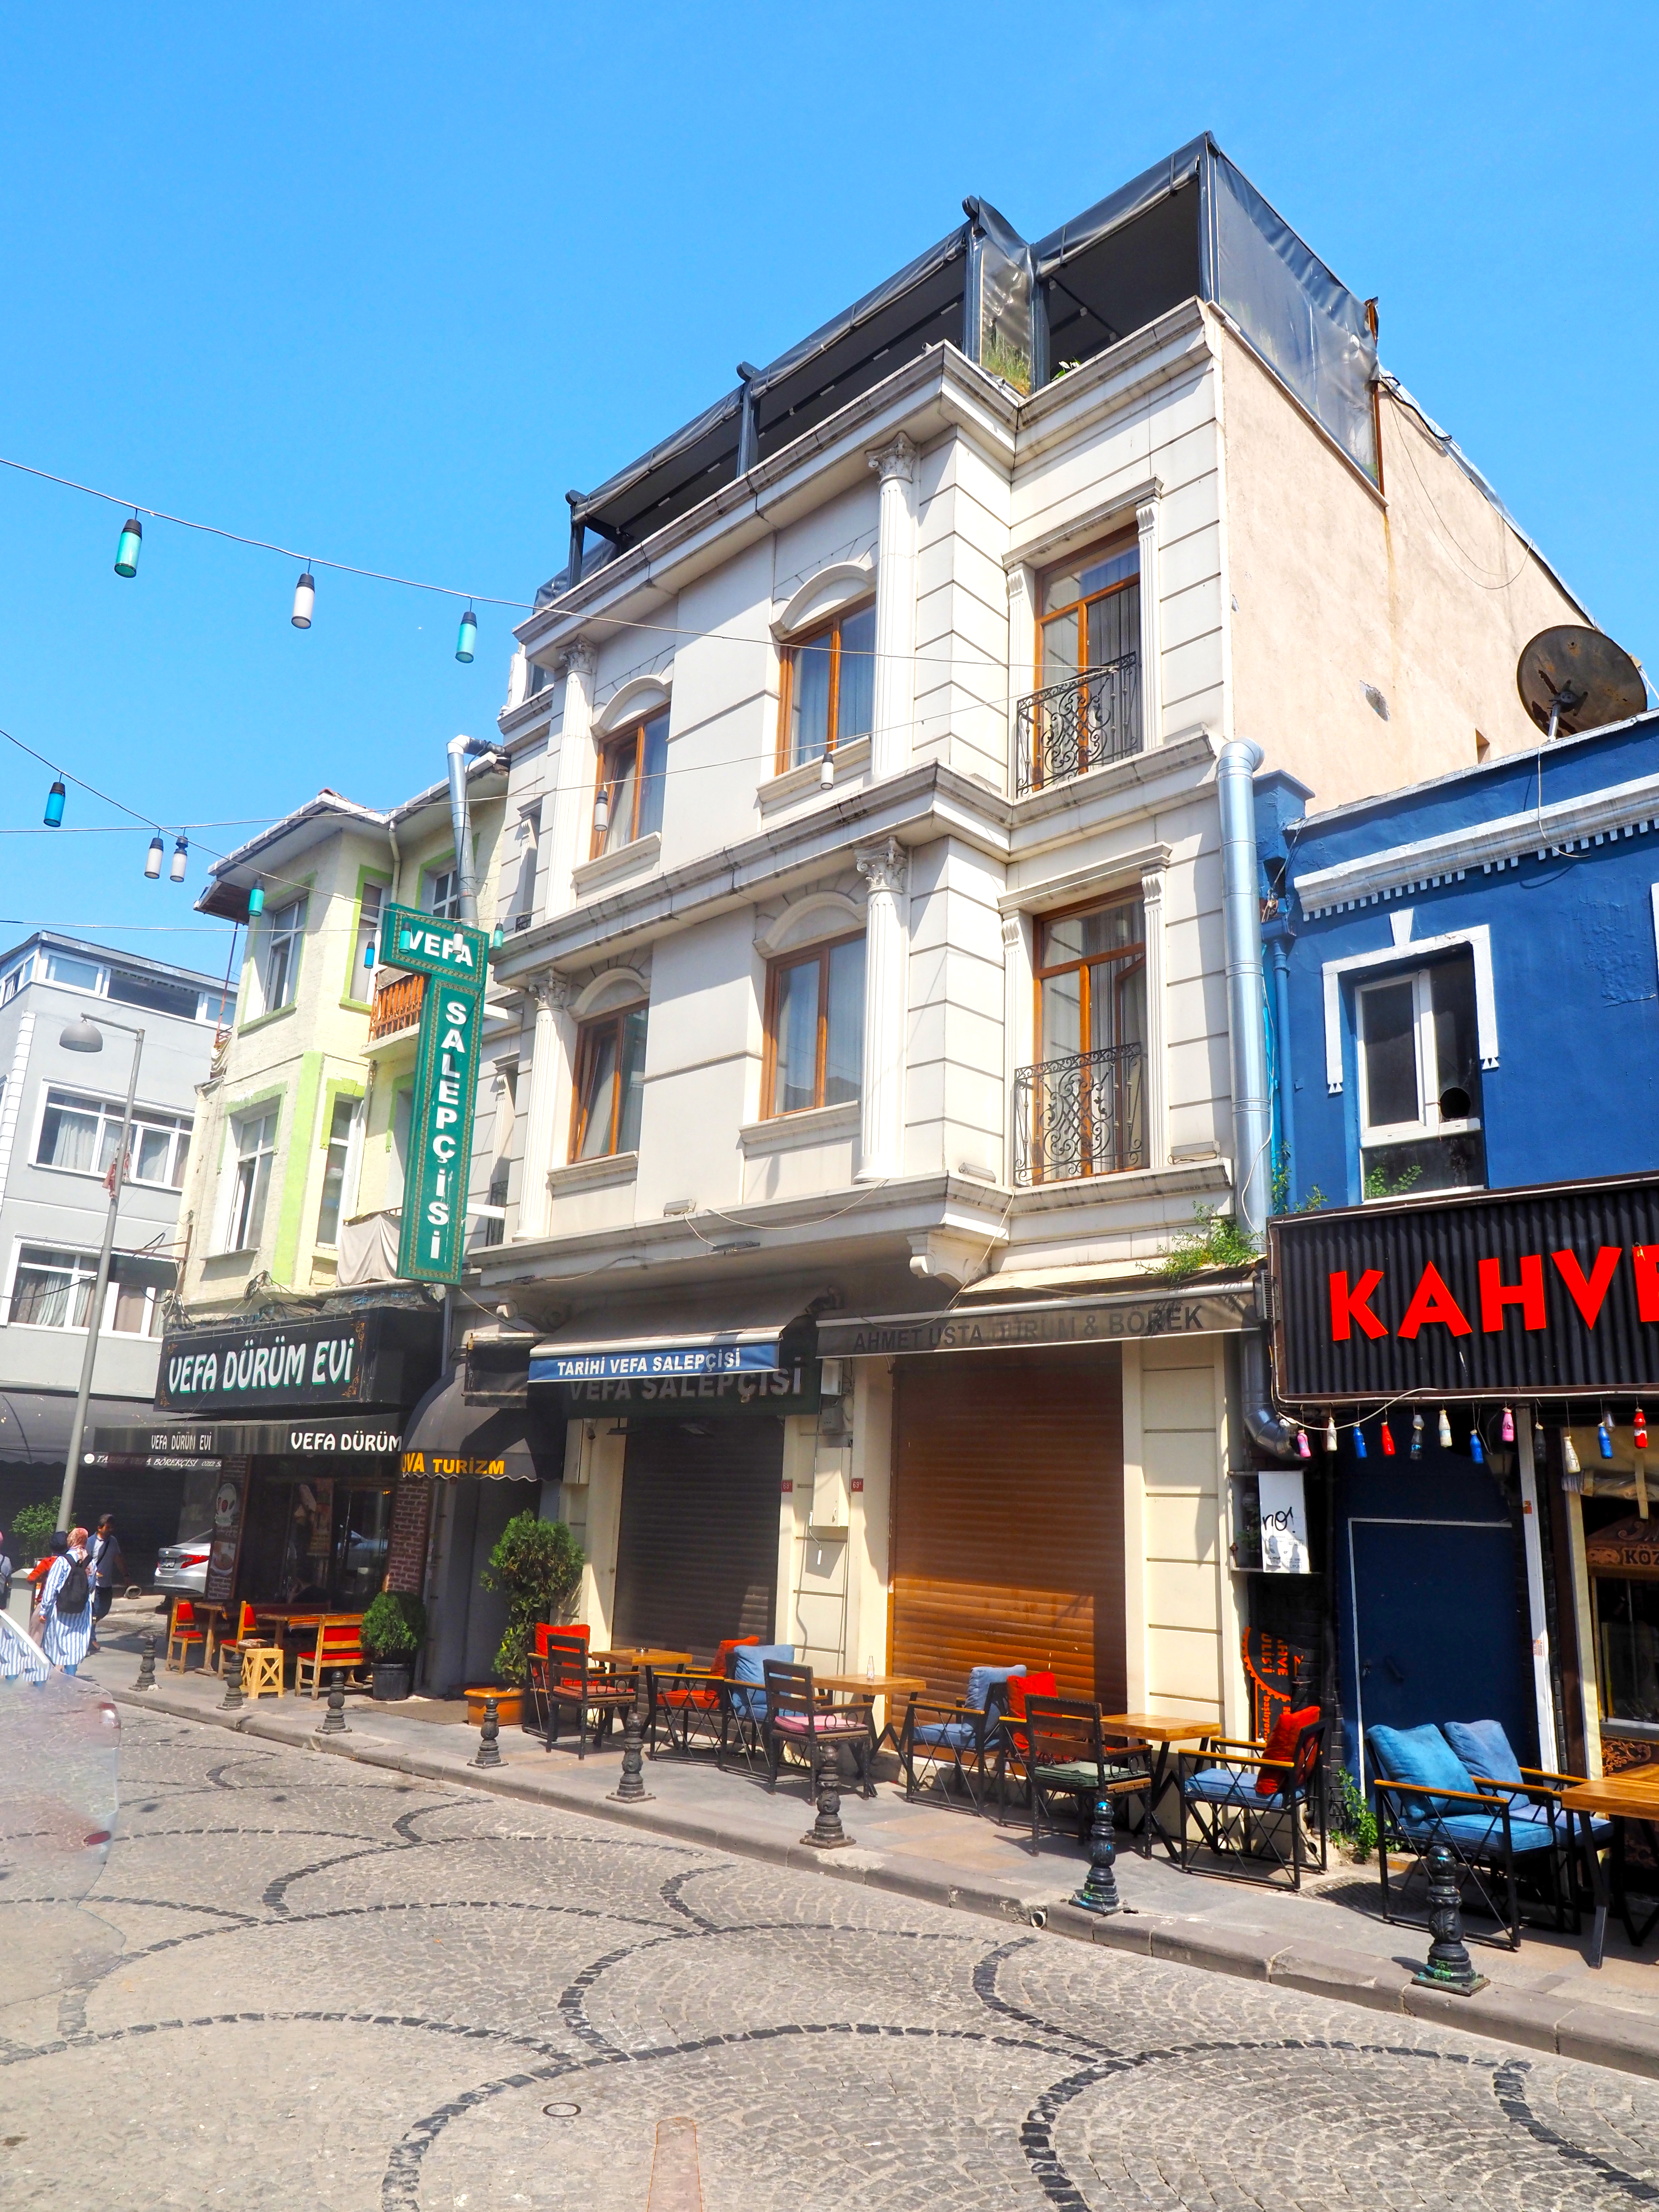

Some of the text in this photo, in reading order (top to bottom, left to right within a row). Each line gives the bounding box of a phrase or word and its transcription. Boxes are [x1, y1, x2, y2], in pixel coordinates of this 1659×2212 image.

[409, 928, 473, 967] VEFA
[427, 1001, 468, 1259] SALEPÇİSİ
[854, 1328, 923, 1352] AHMET
[929, 1324, 982, 1347] USTA
[1083, 1315, 1098, 1337] &
[1109, 1305, 1203, 1336] BÖREK
[169, 1353, 217, 1394] VEFA
[223, 1336, 307, 1391] DÜRÜM
[557, 1348, 741, 1376] TARİHİ VEFA SALEPÇİSİ
[570, 1379, 632, 1401] VEFA
[151, 1432, 212, 1451] VEFA DÜRÜM EVİ
[291, 1430, 402, 1451] VEFA DÜRÜM
[154, 1456, 199, 1467] BÖREKÇİSİ
[433, 1457, 505, 1475] TURİZM
[1277, 1639, 1288, 1676] HVE
